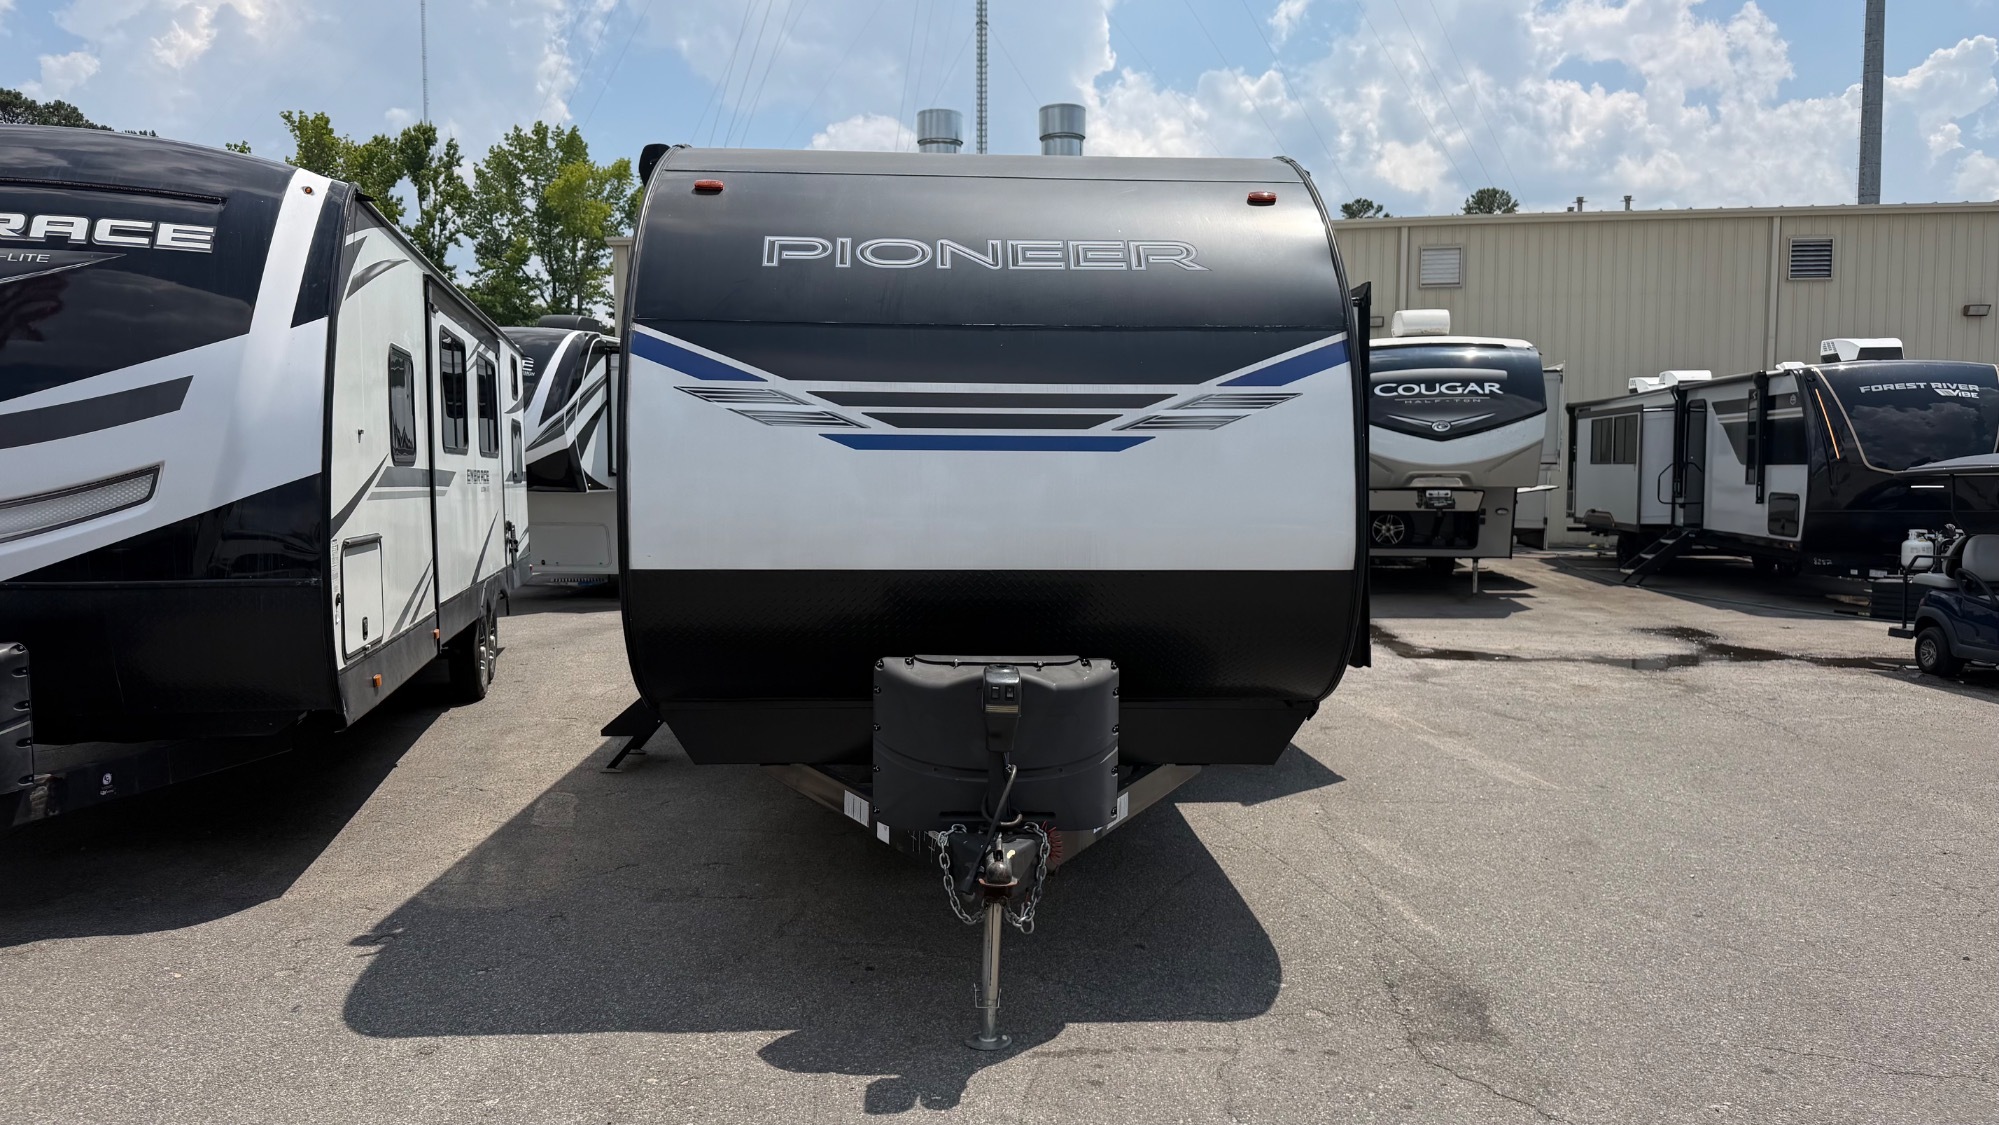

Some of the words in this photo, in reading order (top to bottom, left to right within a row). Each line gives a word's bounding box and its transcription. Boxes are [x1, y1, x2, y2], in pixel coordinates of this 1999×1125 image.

[762, 235, 1212, 271] PIONEER
[1373, 382, 1504, 397] COUGAR
[1859, 382, 1927, 393] FOREST
[1930, 382, 1980, 392] RIVER
